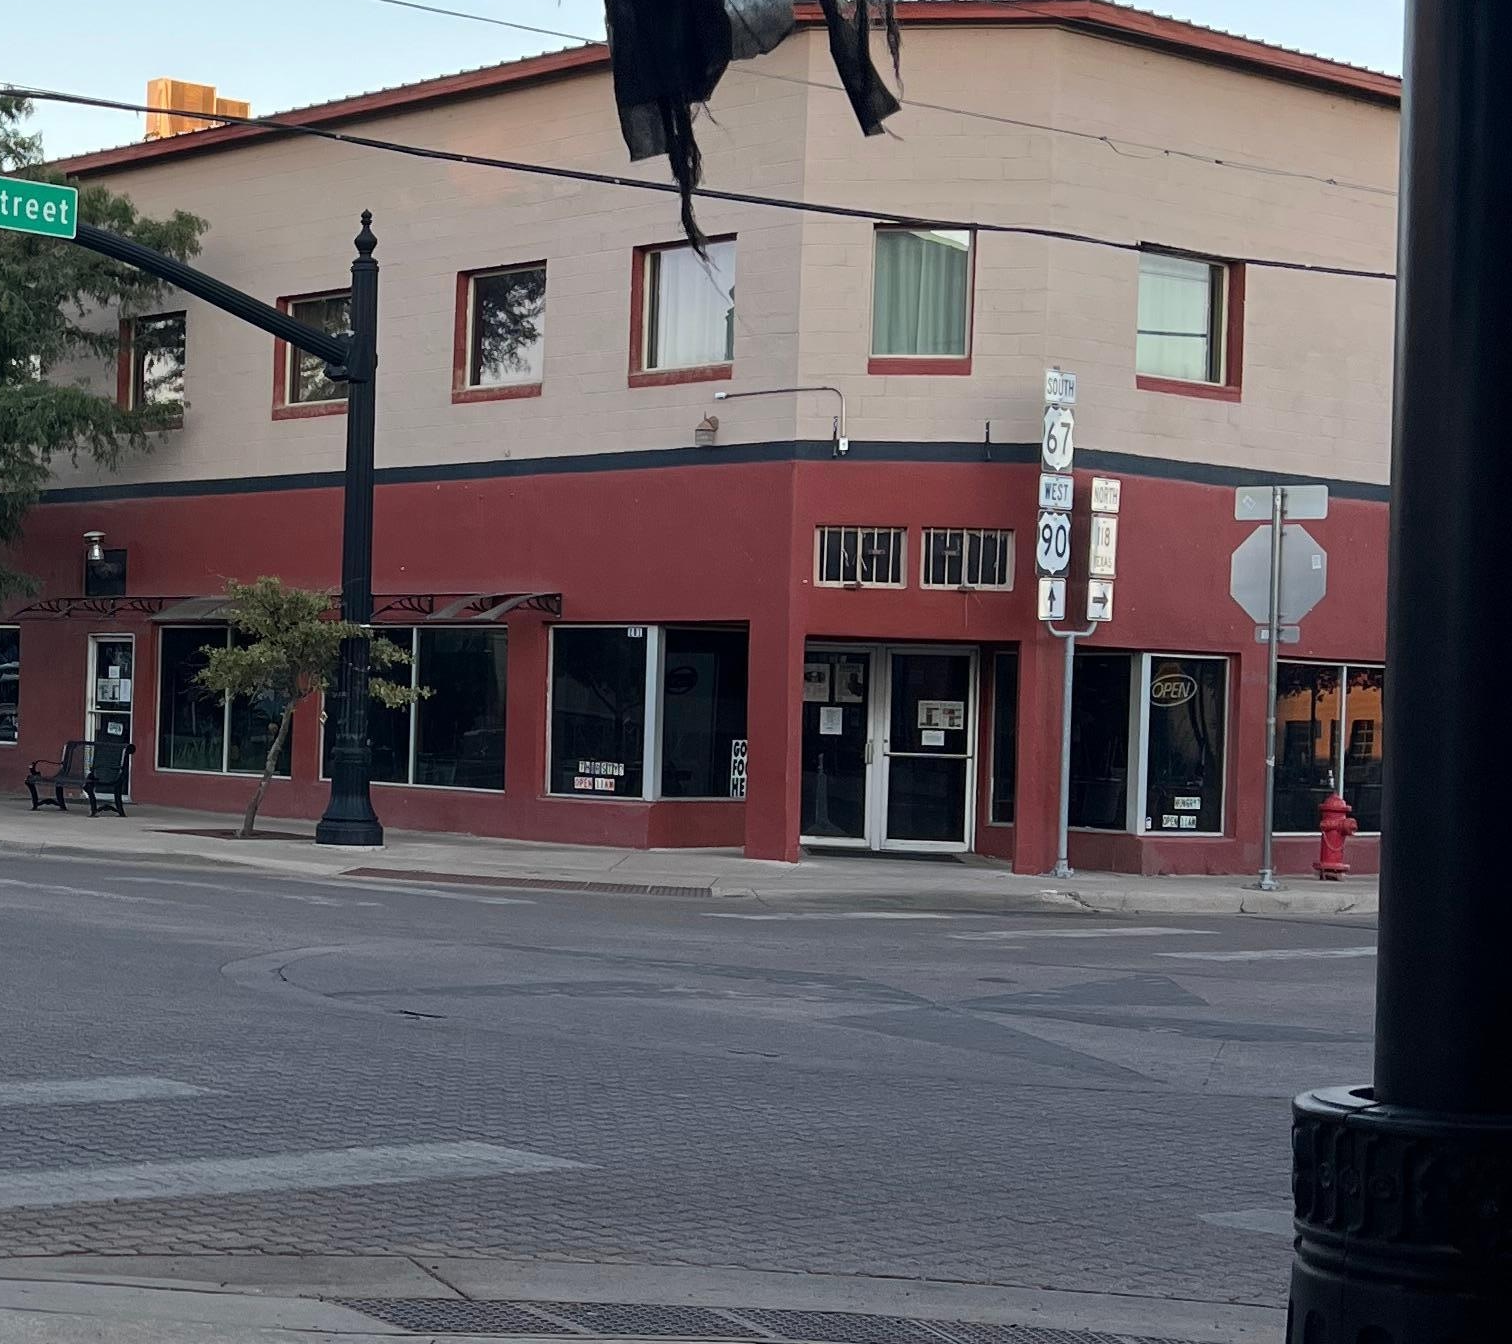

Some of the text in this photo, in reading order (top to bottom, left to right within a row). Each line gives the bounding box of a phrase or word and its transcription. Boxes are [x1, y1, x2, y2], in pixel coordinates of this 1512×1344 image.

[1047, 377, 1075, 397] SOUTH
[1047, 421, 1071, 455] 67
[1044, 483, 1069, 501] WEST
[1094, 486, 1118, 504] NORTH
[1042, 523, 1067, 558] 90
[1097, 526, 1110, 546] 118
[1152, 681, 1191, 698] OPEN
[733, 741, 747, 758] GO
